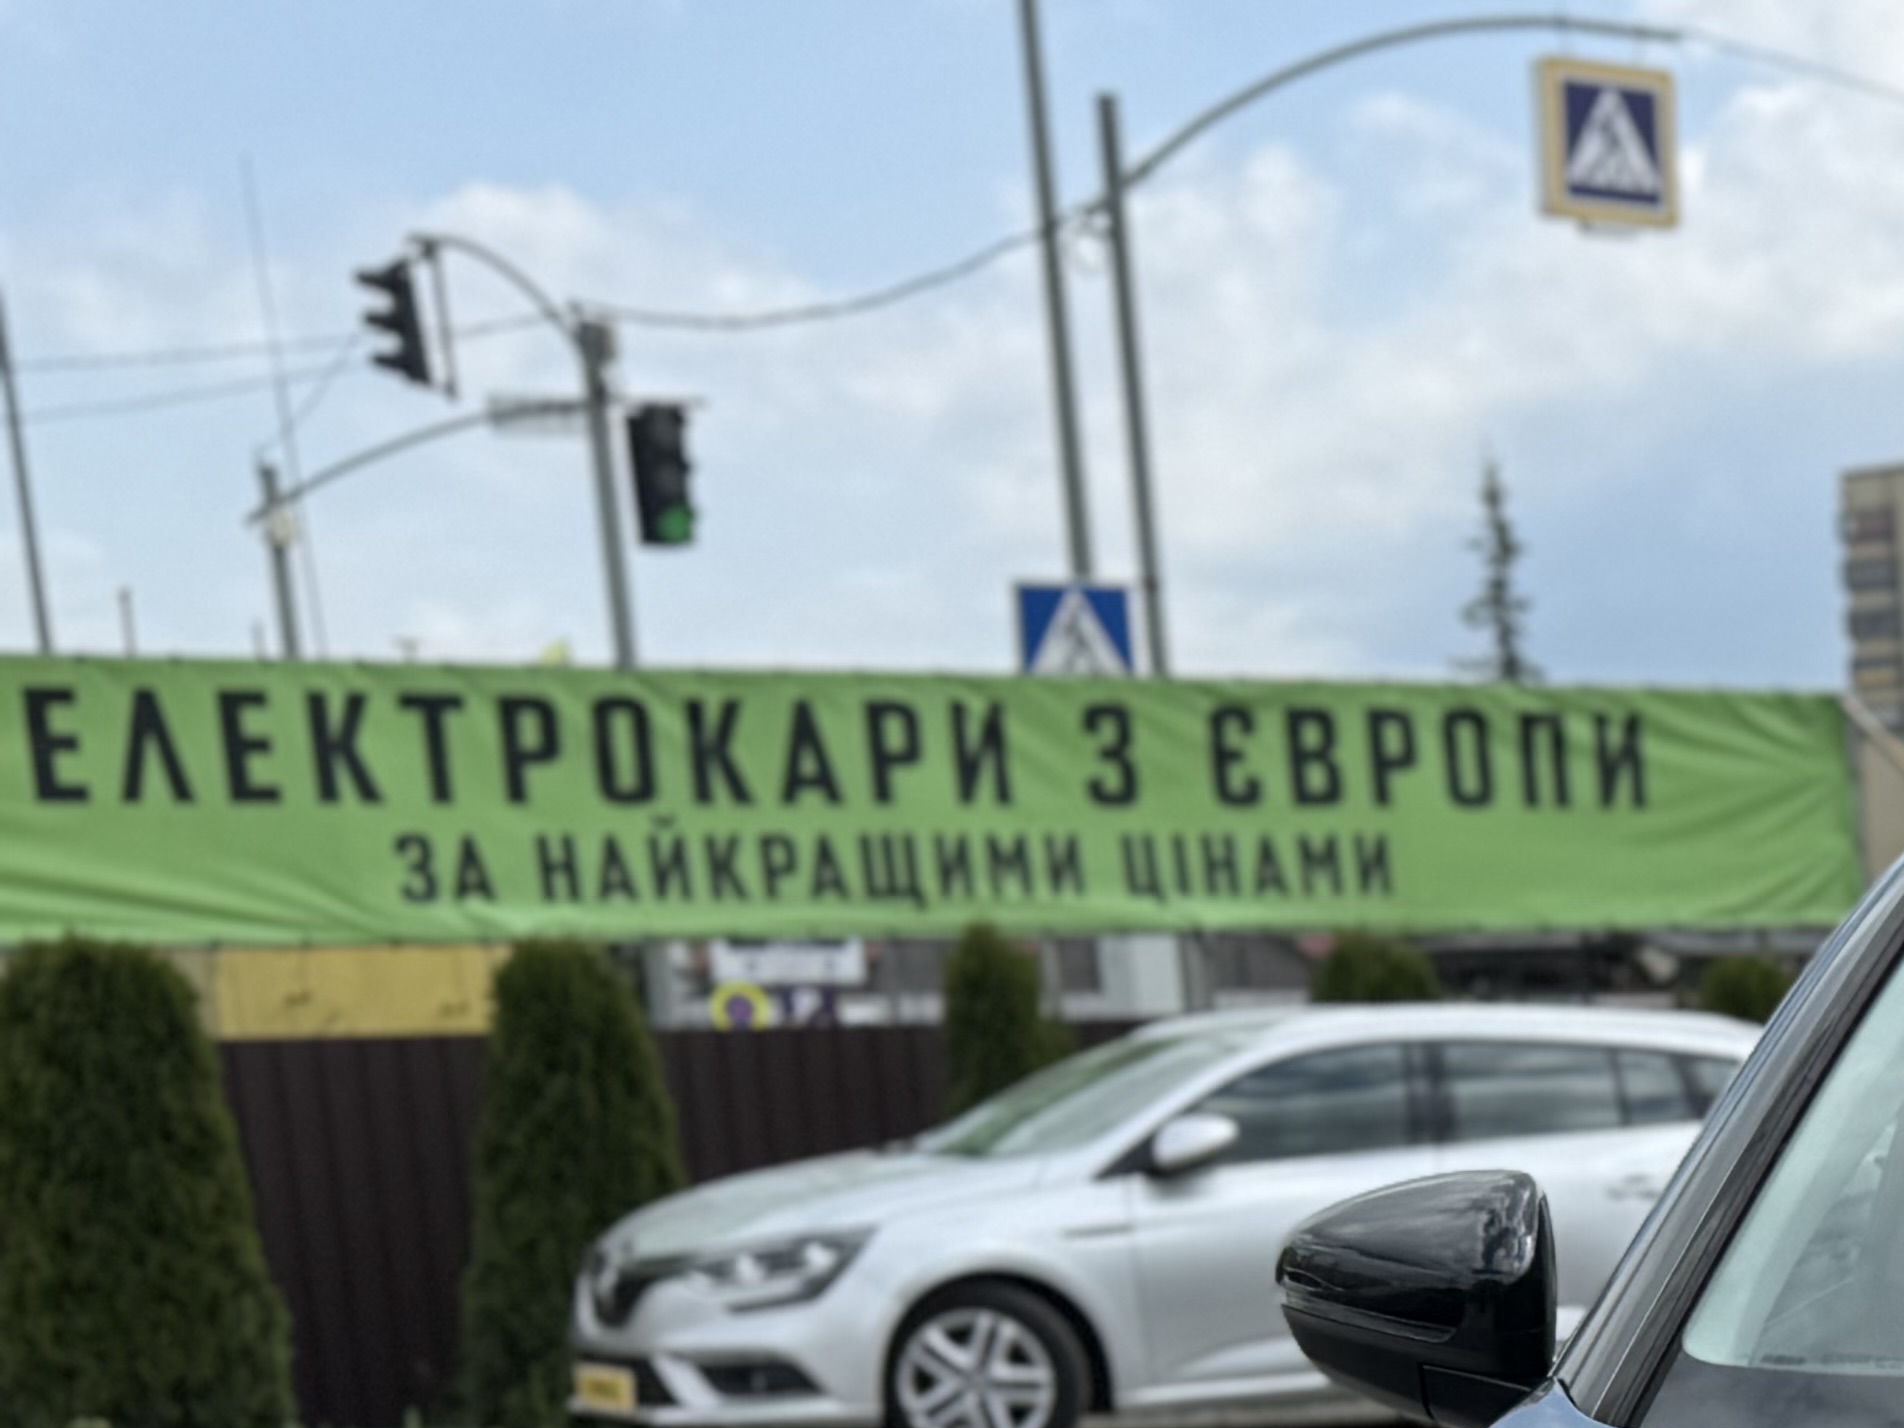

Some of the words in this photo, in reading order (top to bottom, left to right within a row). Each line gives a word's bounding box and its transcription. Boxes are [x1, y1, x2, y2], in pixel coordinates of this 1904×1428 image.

[22, 686, 1012, 806] ЕЛЕКТРОКАРИ
[1081, 702, 1139, 808] З
[1207, 702, 1648, 809] ЄВРОПИ
[394, 834, 495, 902] ЗА
[535, 817, 1084, 909] НАЙКРАЩИМИ
[1121, 834, 1393, 901] ЦІНАМИ
